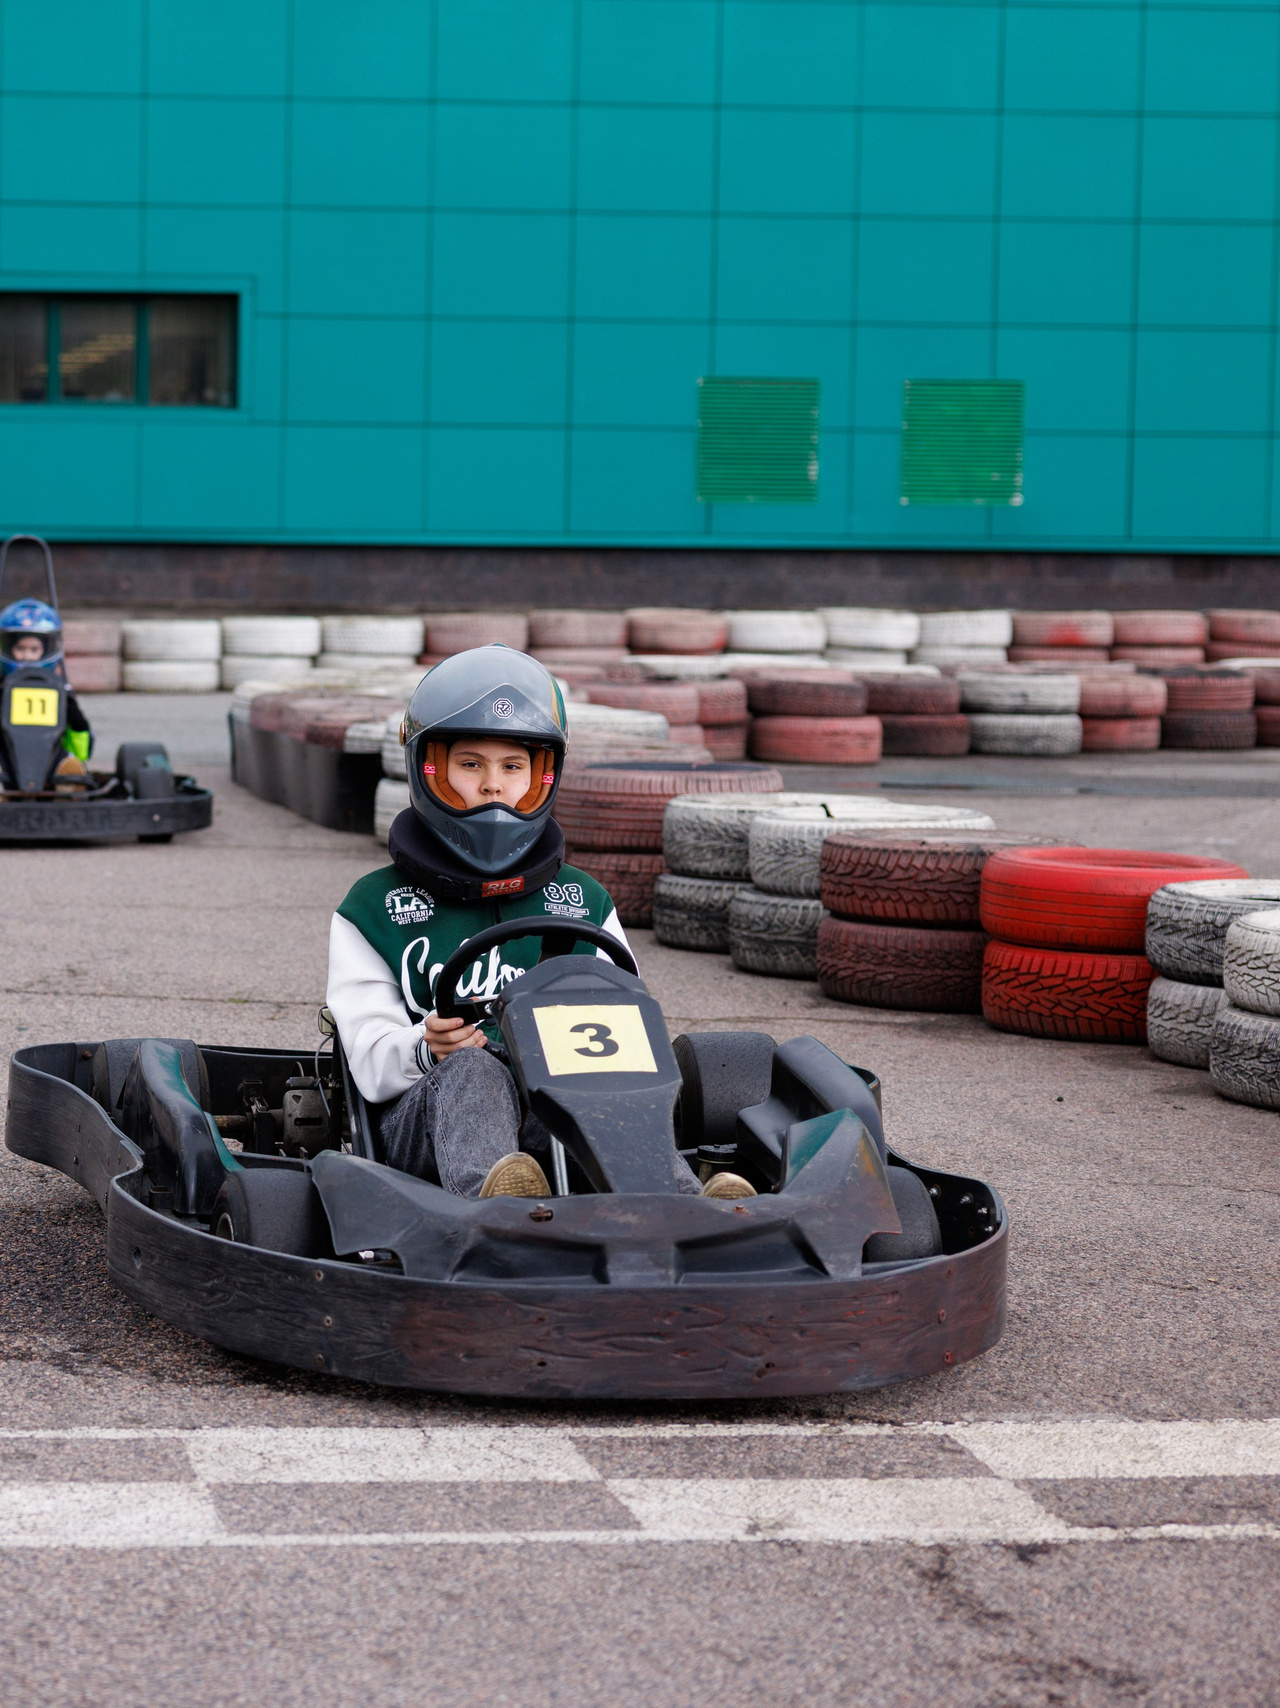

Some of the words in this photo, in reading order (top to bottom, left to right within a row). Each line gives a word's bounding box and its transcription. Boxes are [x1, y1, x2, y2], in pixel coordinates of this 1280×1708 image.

[25, 698, 46, 714] 11
[487, 880, 521, 890] RLG
[385, 887, 413, 907] UNIVERSITY
[543, 882, 583, 907] 88
[392, 896, 428, 913] LA
[391, 909, 434, 922] CALIFORNIA
[569, 1022, 619, 1057] 3
